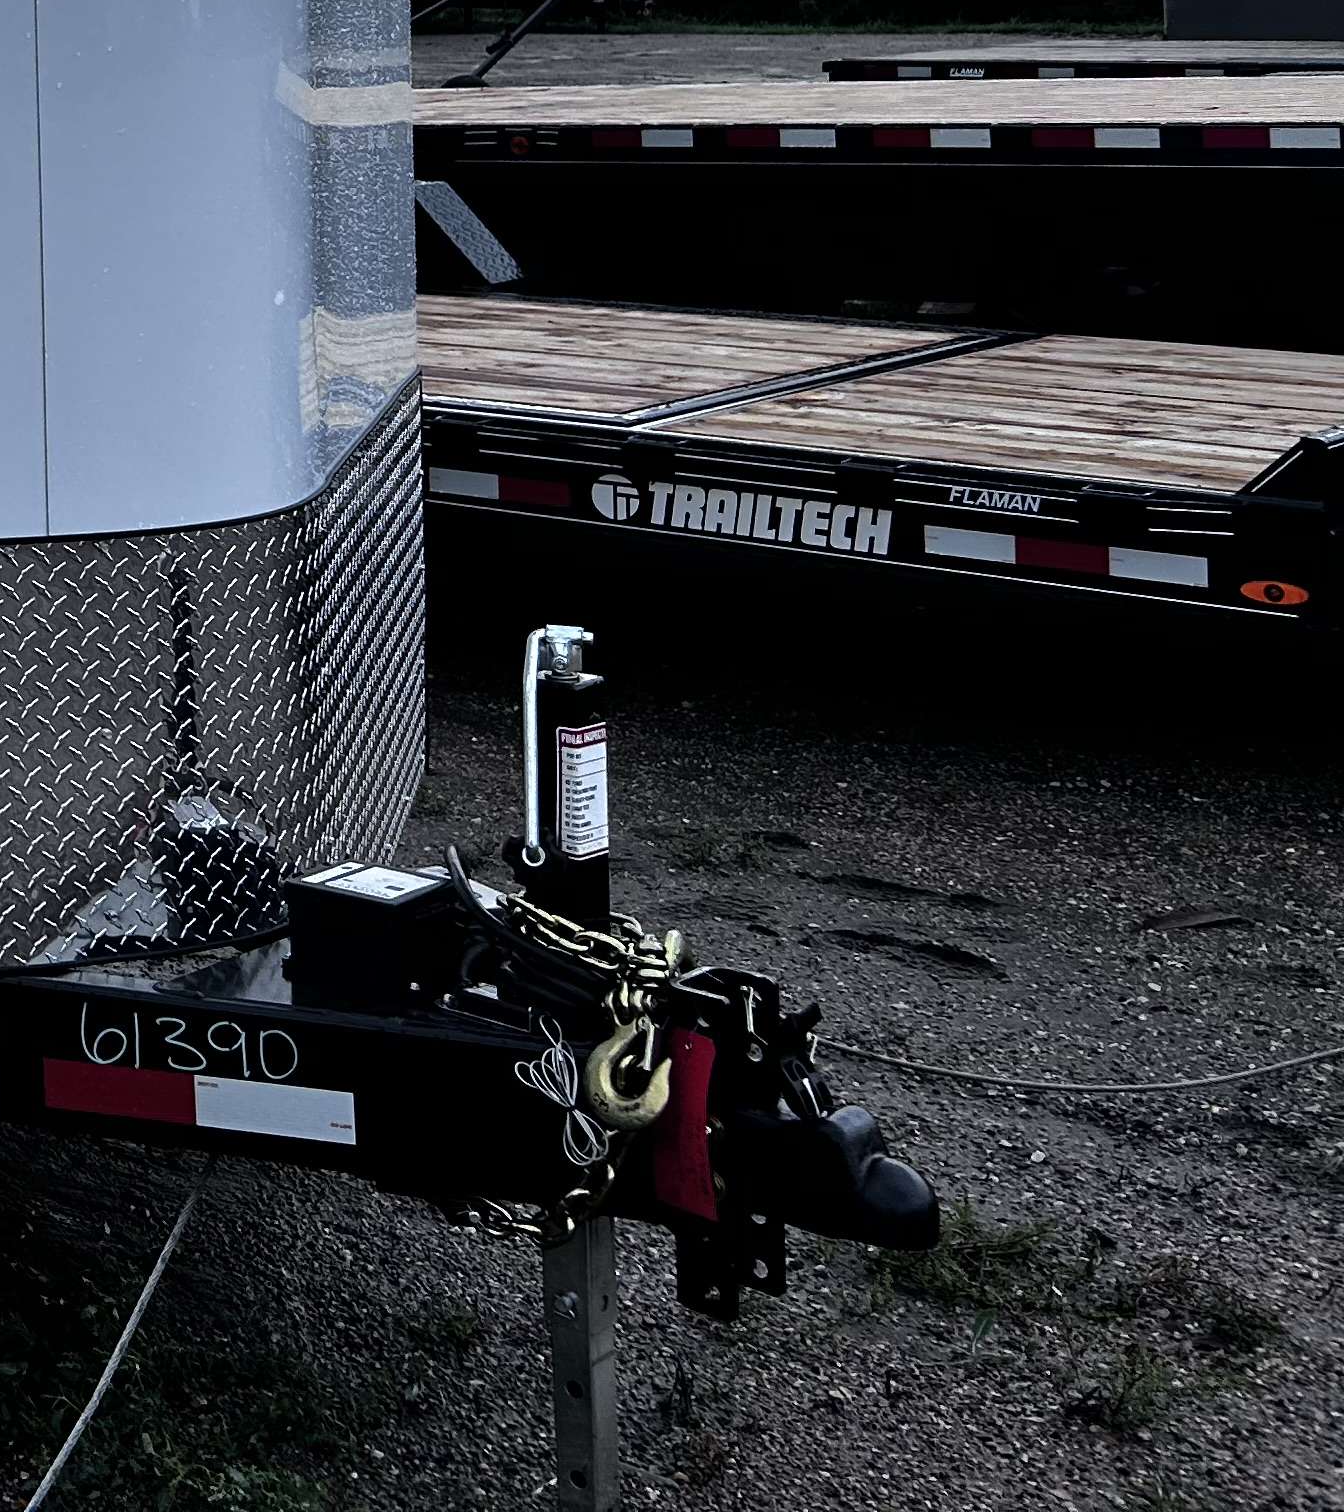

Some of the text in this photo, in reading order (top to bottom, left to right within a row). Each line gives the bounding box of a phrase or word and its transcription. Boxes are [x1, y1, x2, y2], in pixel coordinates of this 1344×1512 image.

[949, 67, 985, 76] FLAMAN
[648, 480, 893, 556] TRAILTECH
[948, 486, 1042, 513] FLAMAN
[80, 1001, 299, 1080] 61390
